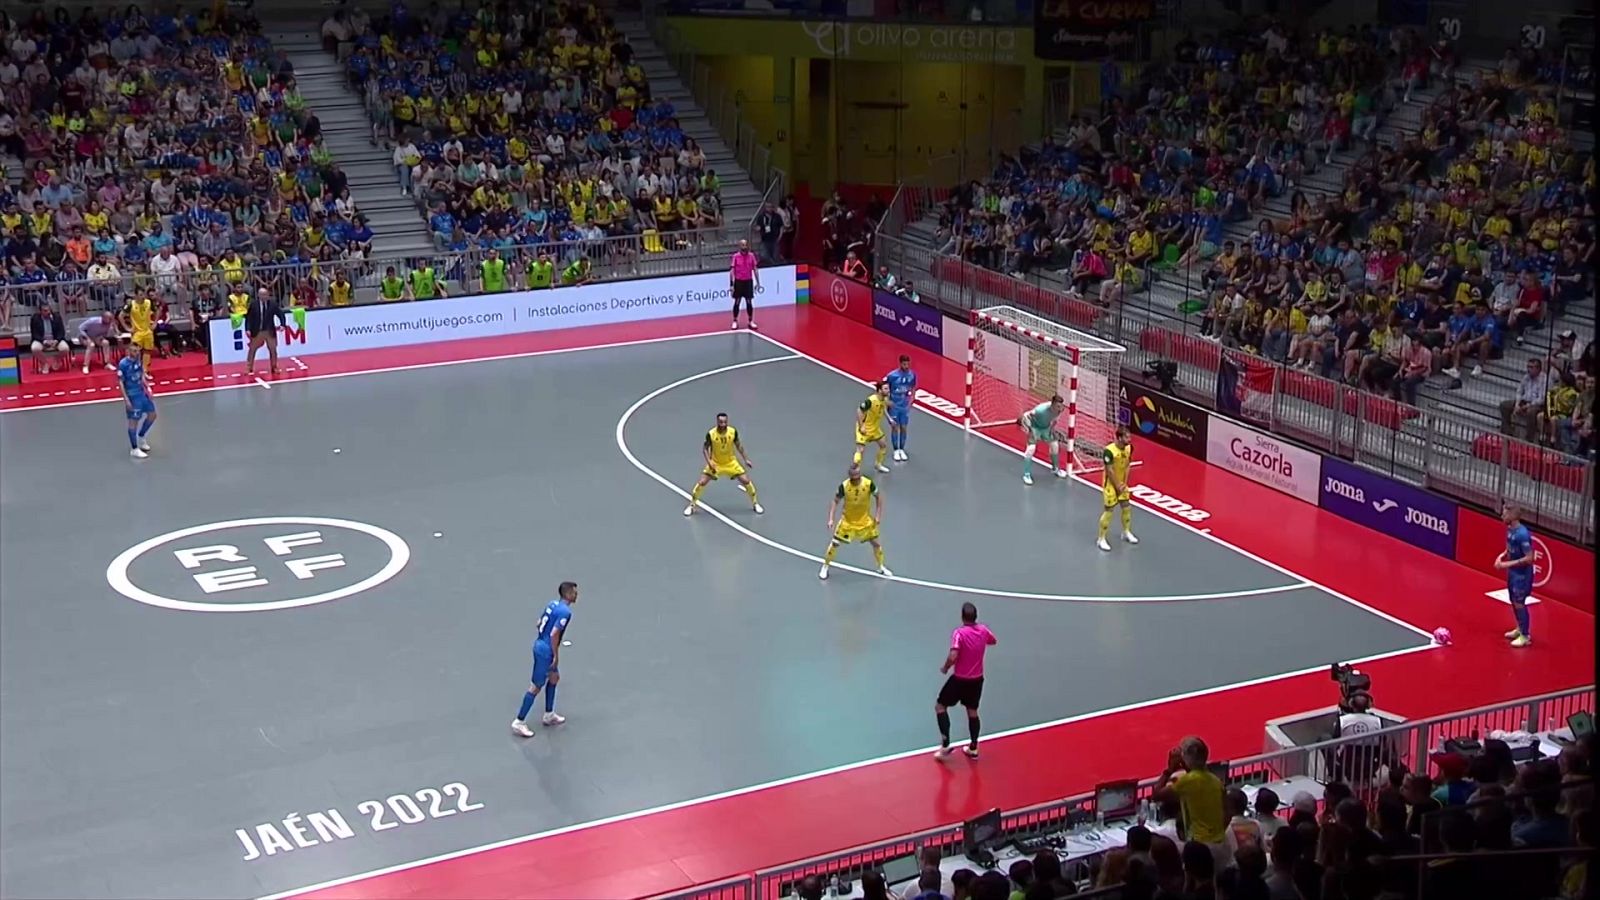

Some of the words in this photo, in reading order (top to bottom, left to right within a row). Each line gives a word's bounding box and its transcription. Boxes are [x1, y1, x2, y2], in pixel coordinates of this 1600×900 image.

[527, 300, 608, 318] Instalaciones
[610, 293, 675, 311] Deportivas
[676, 293, 684, 305] y
[344, 310, 504, 337] www.stmmultijuegos.com
[1230, 437, 1293, 478] Cazorla
[1255, 435, 1279, 454] Sierra
[235, 808, 355, 861] JAÉN
[357, 782, 485, 832] 2022
